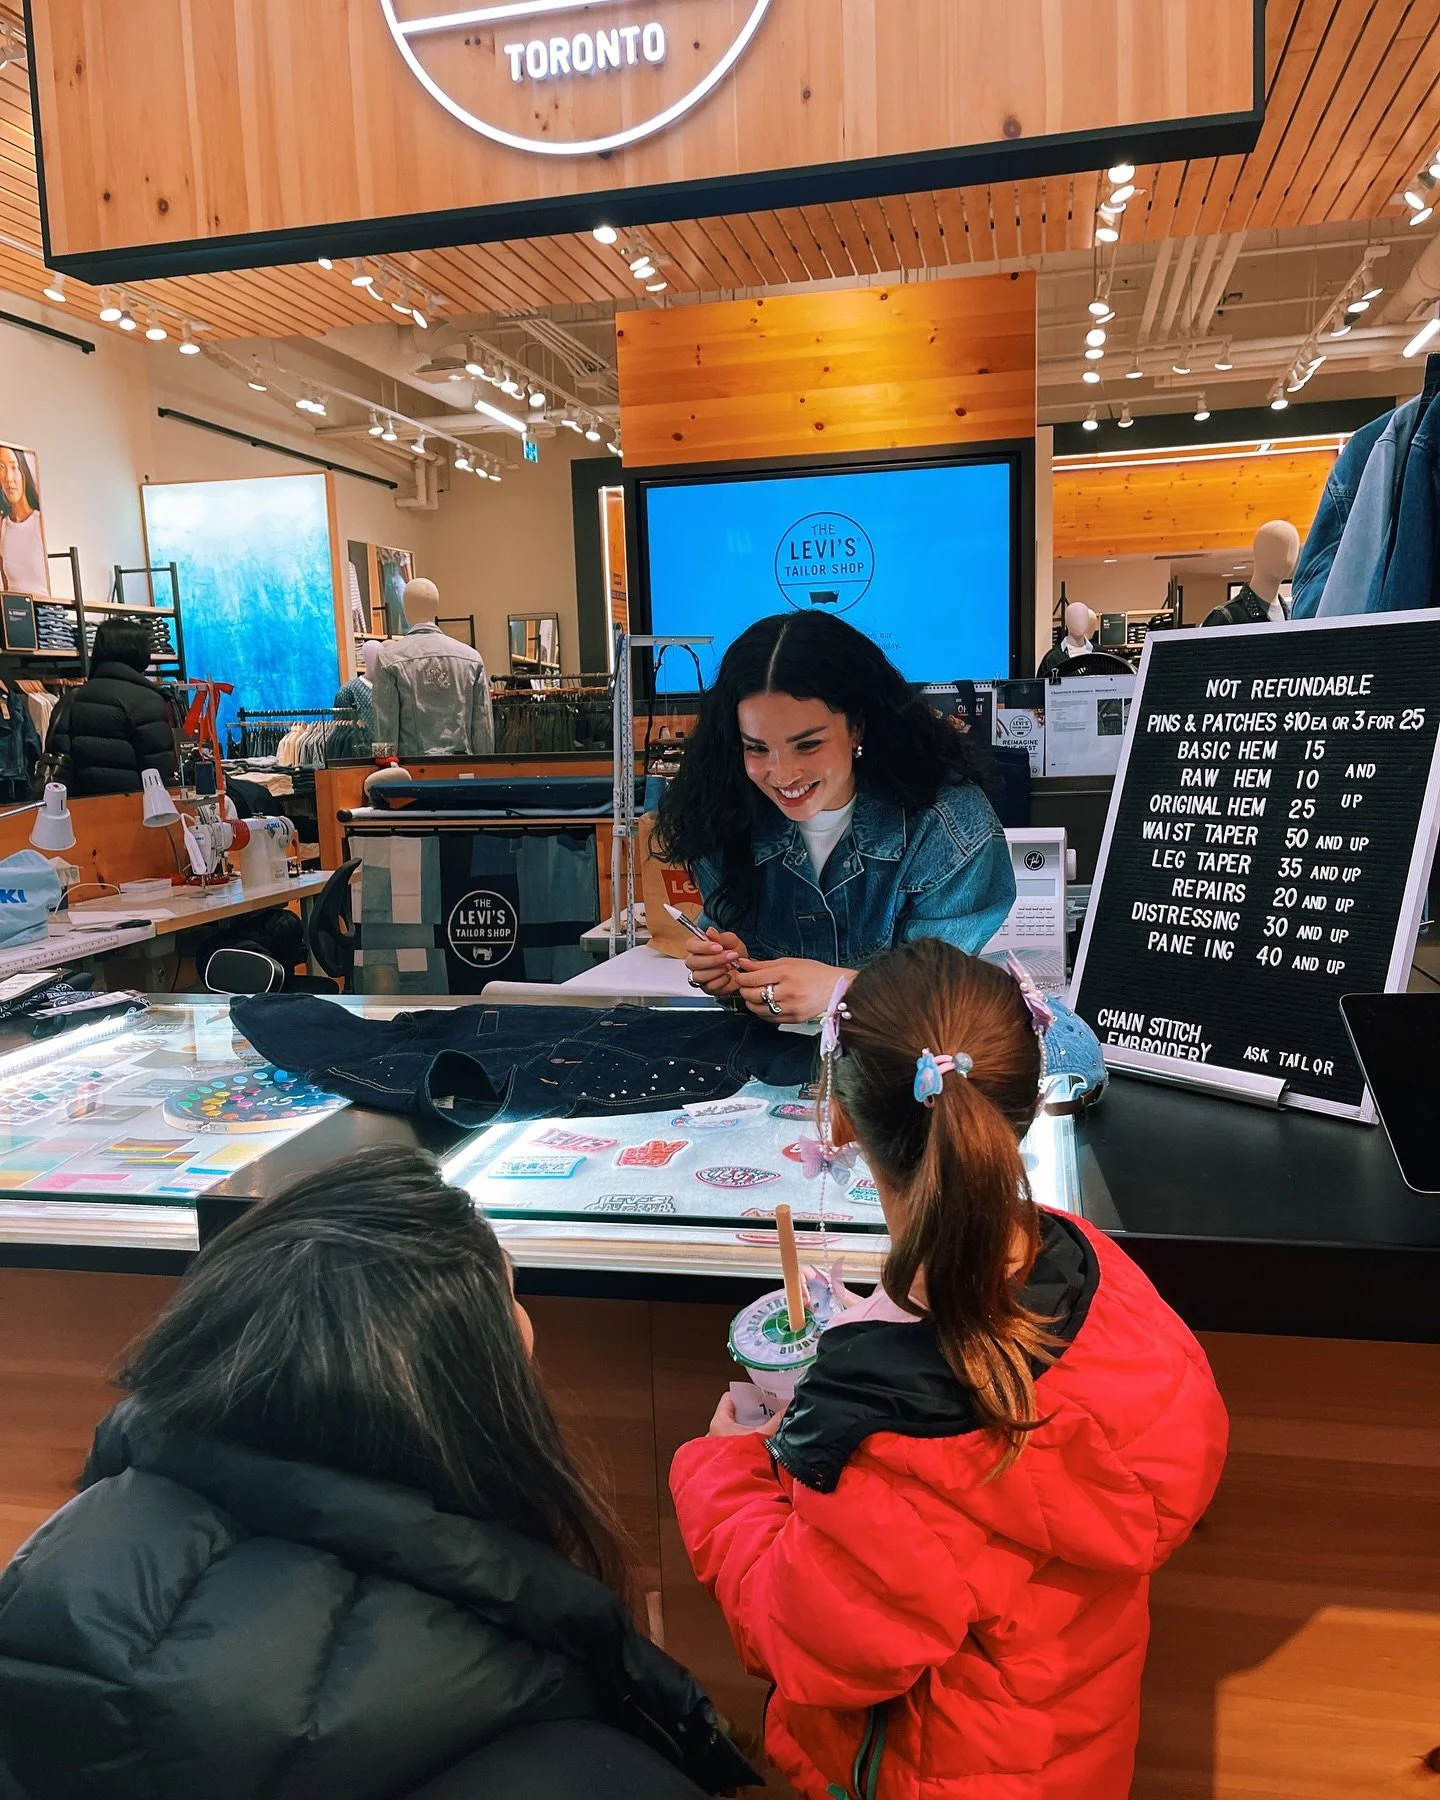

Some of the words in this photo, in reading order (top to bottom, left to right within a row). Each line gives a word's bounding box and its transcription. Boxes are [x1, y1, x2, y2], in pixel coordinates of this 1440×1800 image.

[504, 22, 665, 82] TORONTO
[811, 524, 836, 536] THE
[790, 537, 857, 561] LEVI'S
[785, 564, 827, 577] TAILOR
[832, 562, 865, 575] SHOP
[1206, 679, 1241, 699] NOT
[1251, 674, 1374, 699] REFUNDABLE
[1147, 714, 1181, 732] PINS
[1185, 714, 1196, 732] &
[1202, 713, 1277, 732] PATCHES
[1332, 717, 1349, 729] OR
[1352, 710, 1365, 730] 3
[1367, 716, 1394, 729] FOR
[1399, 708, 1425, 730] 25
[1178, 741, 1231, 760] BASIC
[1238, 741, 1278, 759] HEM
[1305, 740, 1325, 759] 15
[1181, 768, 1219, 787] RAW
[1234, 769, 1271, 788] HEM
[1297, 770, 1319, 789] 10
[1345, 764, 1375, 778] AND
[1150, 795, 1221, 815] ORIGINAL
[1228, 797, 1266, 816] HEM
[1289, 799, 1315, 819] 25
[1341, 794, 1362, 808] UP
[1143, 821, 1195, 841] WAIST
[1205, 824, 1258, 845] TAPER
[1285, 828, 1308, 848] 50
[1315, 836, 1342, 850] AND
[1350, 837, 1369, 851] UP
[1152, 849, 1186, 868] LEG
[1197, 852, 1251, 874] TAPER
[1278, 858, 1302, 878] 35
[1310, 866, 1338, 880] AND
[1342, 868, 1361, 883] UP
[473, 898, 492, 908] THE
[1172, 878, 1246, 902] REPAIRS
[1273, 887, 1297, 908] 20
[1302, 896, 1327, 910] AND
[1336, 898, 1354, 912] UP
[459, 909, 506, 925] LEVI'S
[1131, 901, 1241, 932] DISTRESSING
[1263, 916, 1288, 937] 30
[1296, 925, 1322, 940] AND
[1330, 929, 1349, 943] UP
[456, 928, 485, 937] TAILOR
[487, 928, 511, 938] SHOP
[1256, 946, 1282, 966] 40
[1292, 956, 1319, 971] AND
[1327, 960, 1345, 974] UP
[1097, 1008, 1145, 1033] CHAIN
[1148, 1017, 1202, 1044] STITCH
[1107, 1031, 1212, 1062] EMBROIDERY
[1243, 1046, 1269, 1063] ASK
[1279, 1052, 1335, 1076] TAILOR
